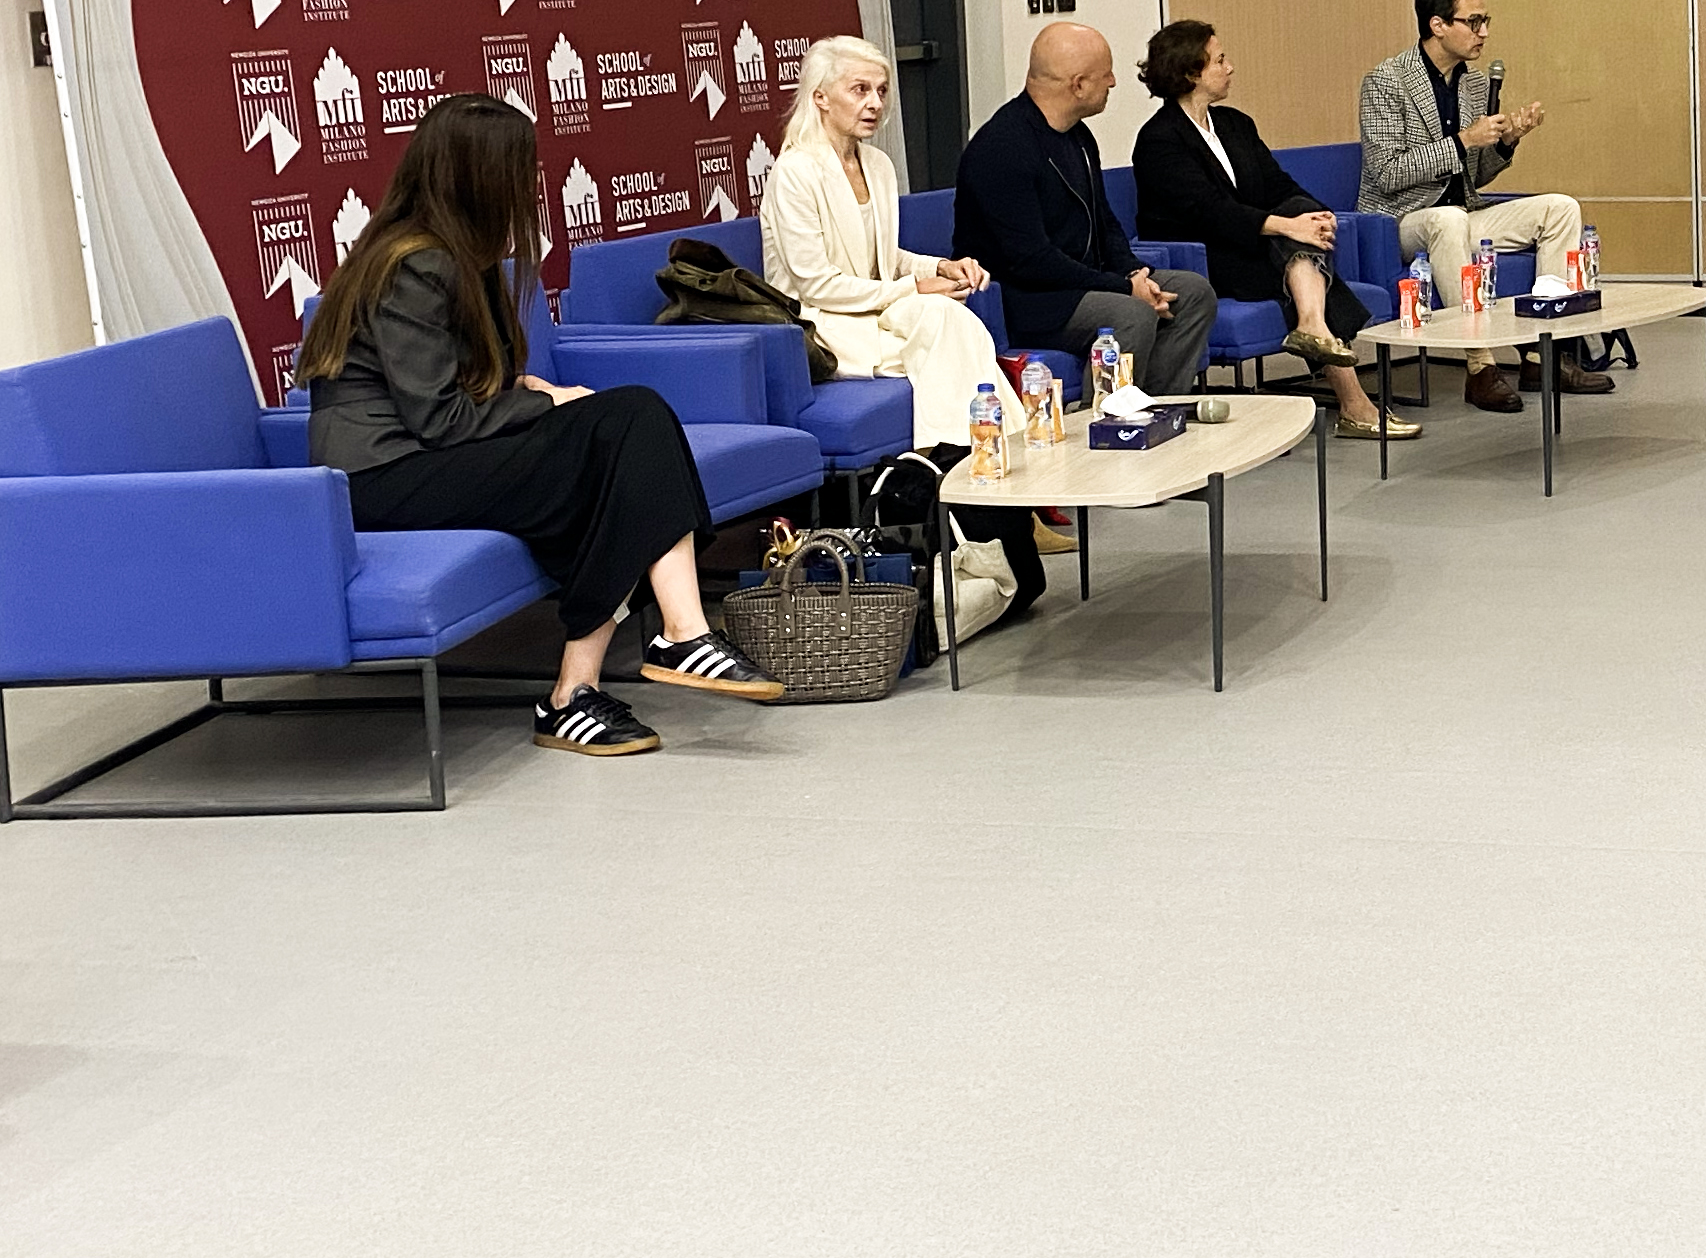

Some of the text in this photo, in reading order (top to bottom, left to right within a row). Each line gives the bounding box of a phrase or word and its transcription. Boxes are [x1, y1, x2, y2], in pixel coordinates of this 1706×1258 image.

[303, 0, 348, 11] FASHION
[303, 11, 350, 22] INSTITUTE
[688, 42, 718, 58] NGU.
[491, 57, 527, 75] NGU.
[597, 51, 644, 74] SCHOOL
[779, 61, 800, 81] ARTS
[242, 76, 288, 95] NGU.
[377, 67, 445, 94] SCHOOL of
[602, 73, 677, 100] ARTS & DESIGN
[382, 98, 416, 123] ARTS
[418, 99, 427, 119] &
[551, 101, 588, 115] MILANO
[553, 113, 590, 126] FASHION
[320, 125, 366, 140] MILANO
[322, 139, 367, 153] FASHION
[323, 151, 369, 164] INSTITUTE
[701, 157, 731, 174] NGU.
[611, 171, 658, 197] SCHOOL
[616, 191, 690, 222] ARTS & DESIGN
[263, 220, 308, 242] NGU.
